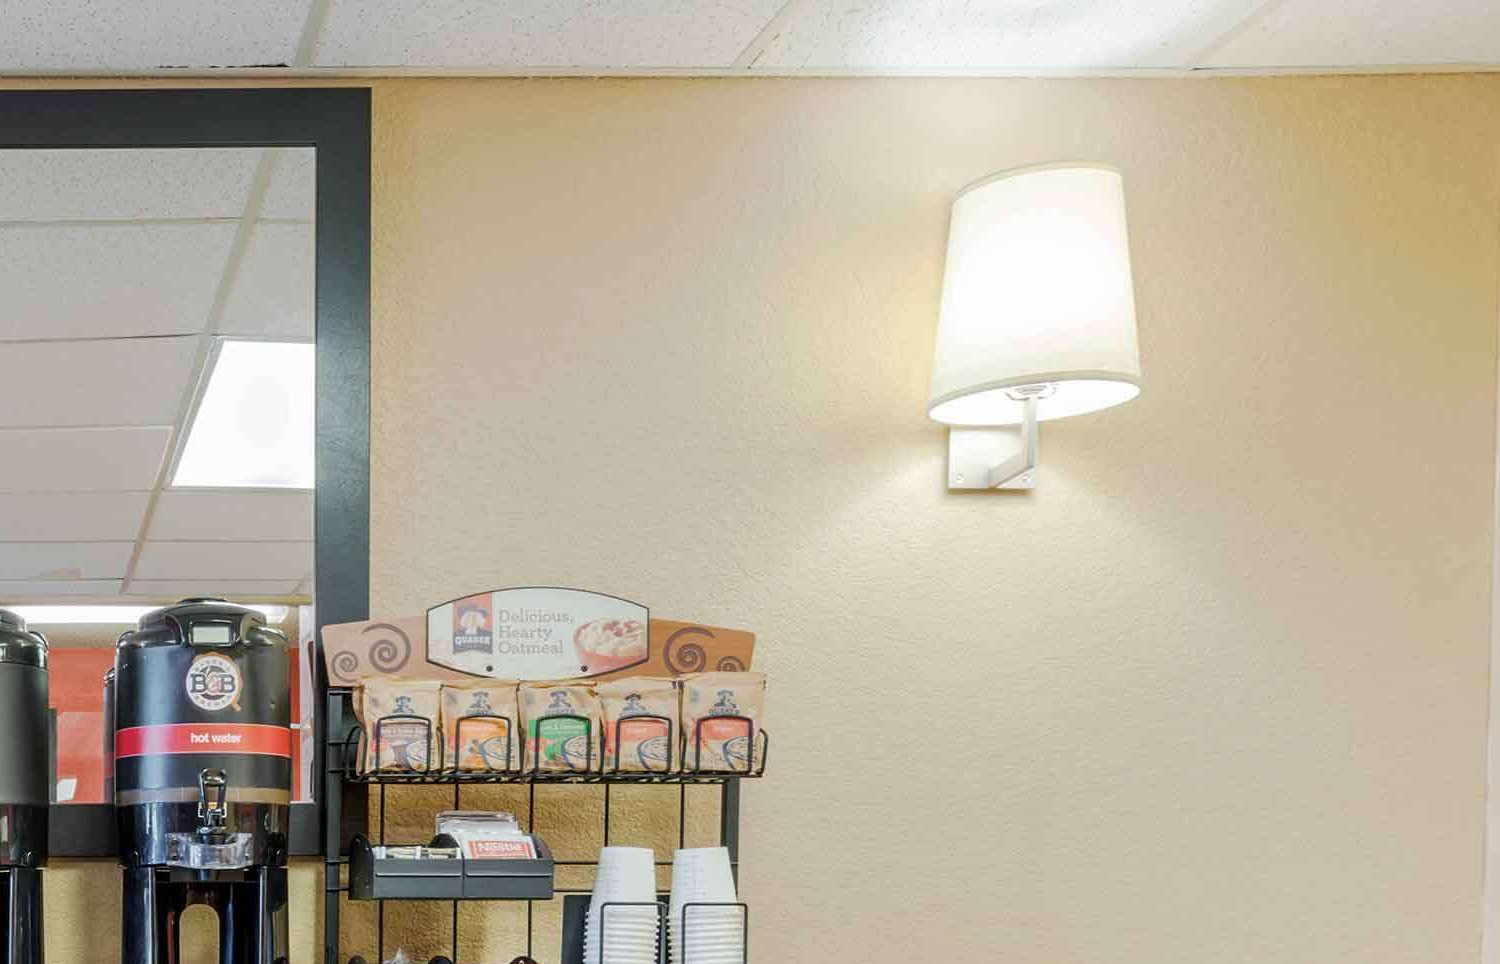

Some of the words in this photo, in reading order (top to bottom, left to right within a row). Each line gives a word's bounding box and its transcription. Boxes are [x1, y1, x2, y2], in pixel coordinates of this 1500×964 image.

[498, 608, 574, 623] Delicious,
[499, 625, 553, 641] Hearty
[498, 640, 564, 655] Oatmeal
[190, 732, 209, 744] hot
[211, 733, 242, 744] water
